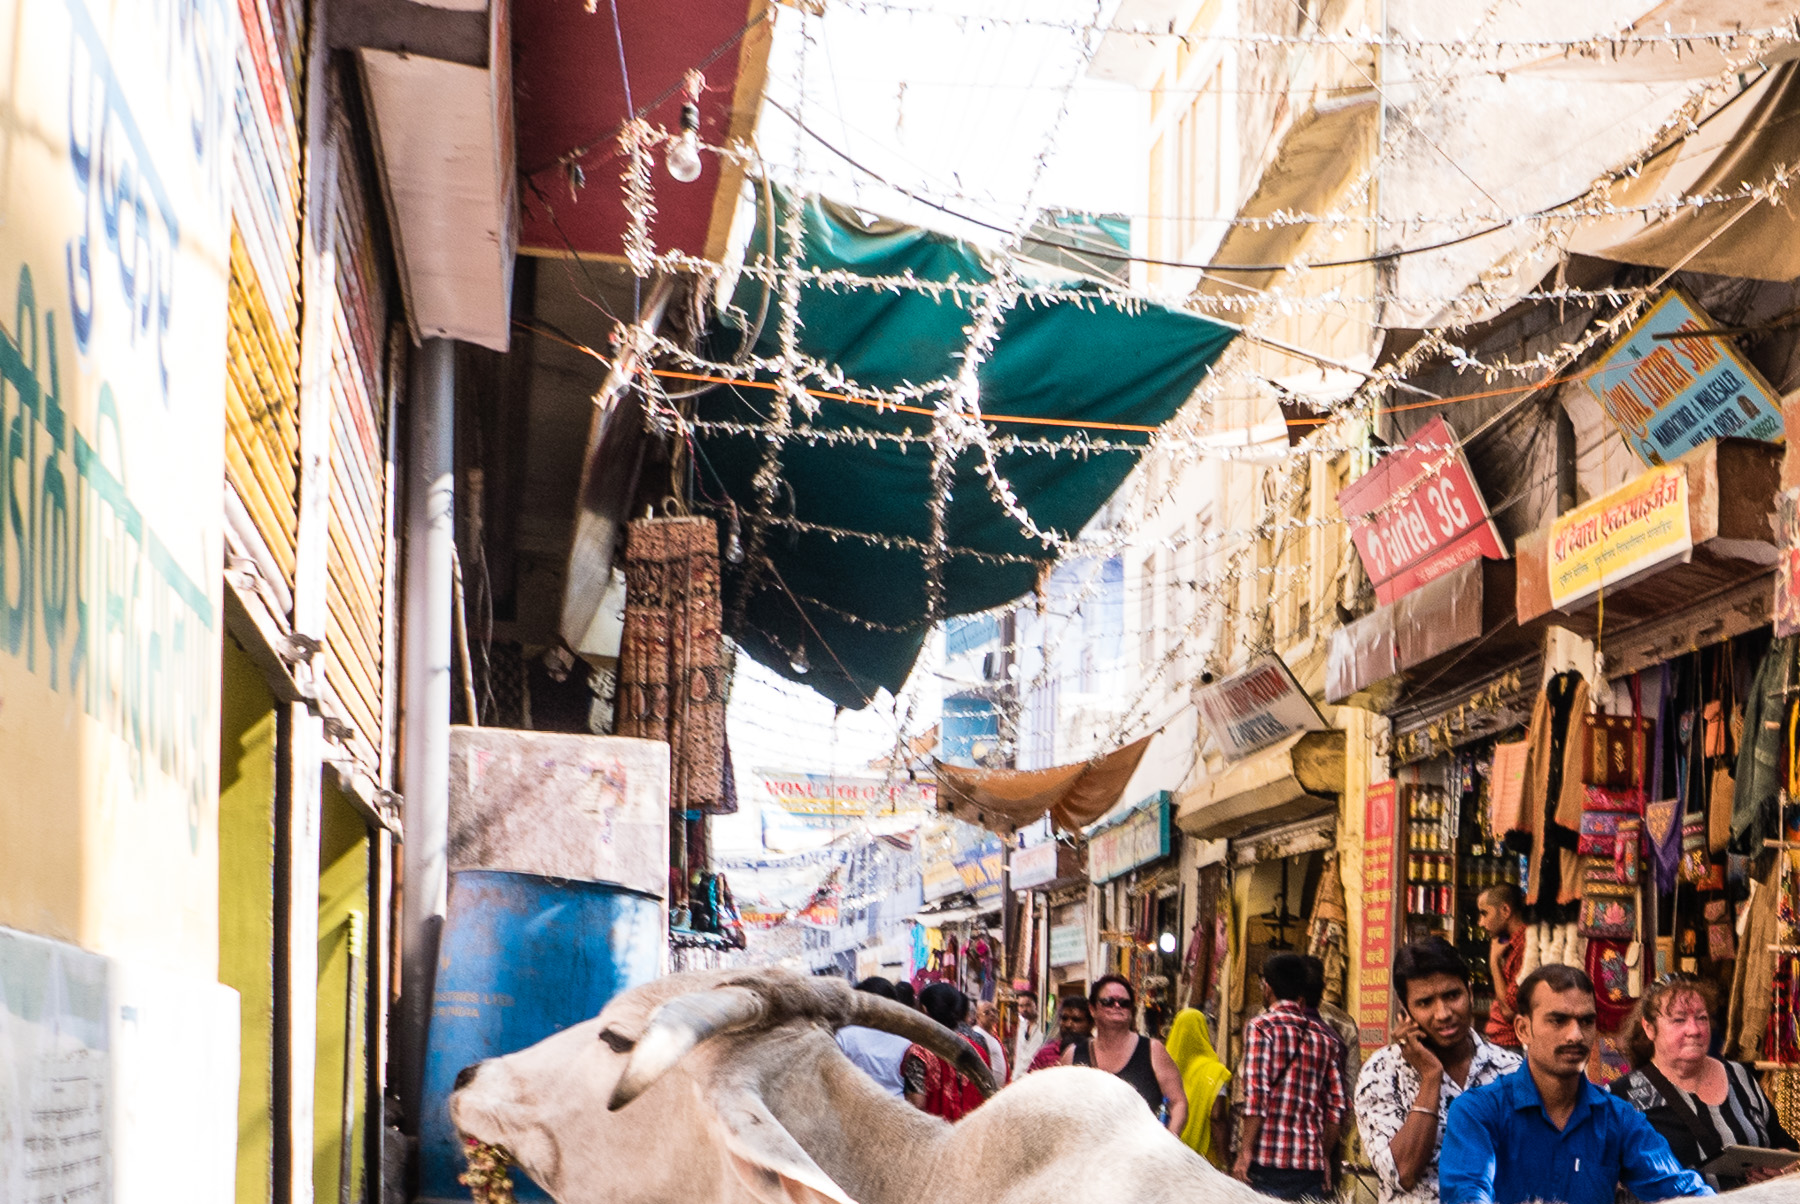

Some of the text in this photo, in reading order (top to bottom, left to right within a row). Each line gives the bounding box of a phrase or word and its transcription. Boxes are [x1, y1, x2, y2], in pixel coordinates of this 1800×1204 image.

[1602, 318, 1725, 440] ROYAL LEATHER SHOP
[1383, 476, 1471, 568] airtel 3G
